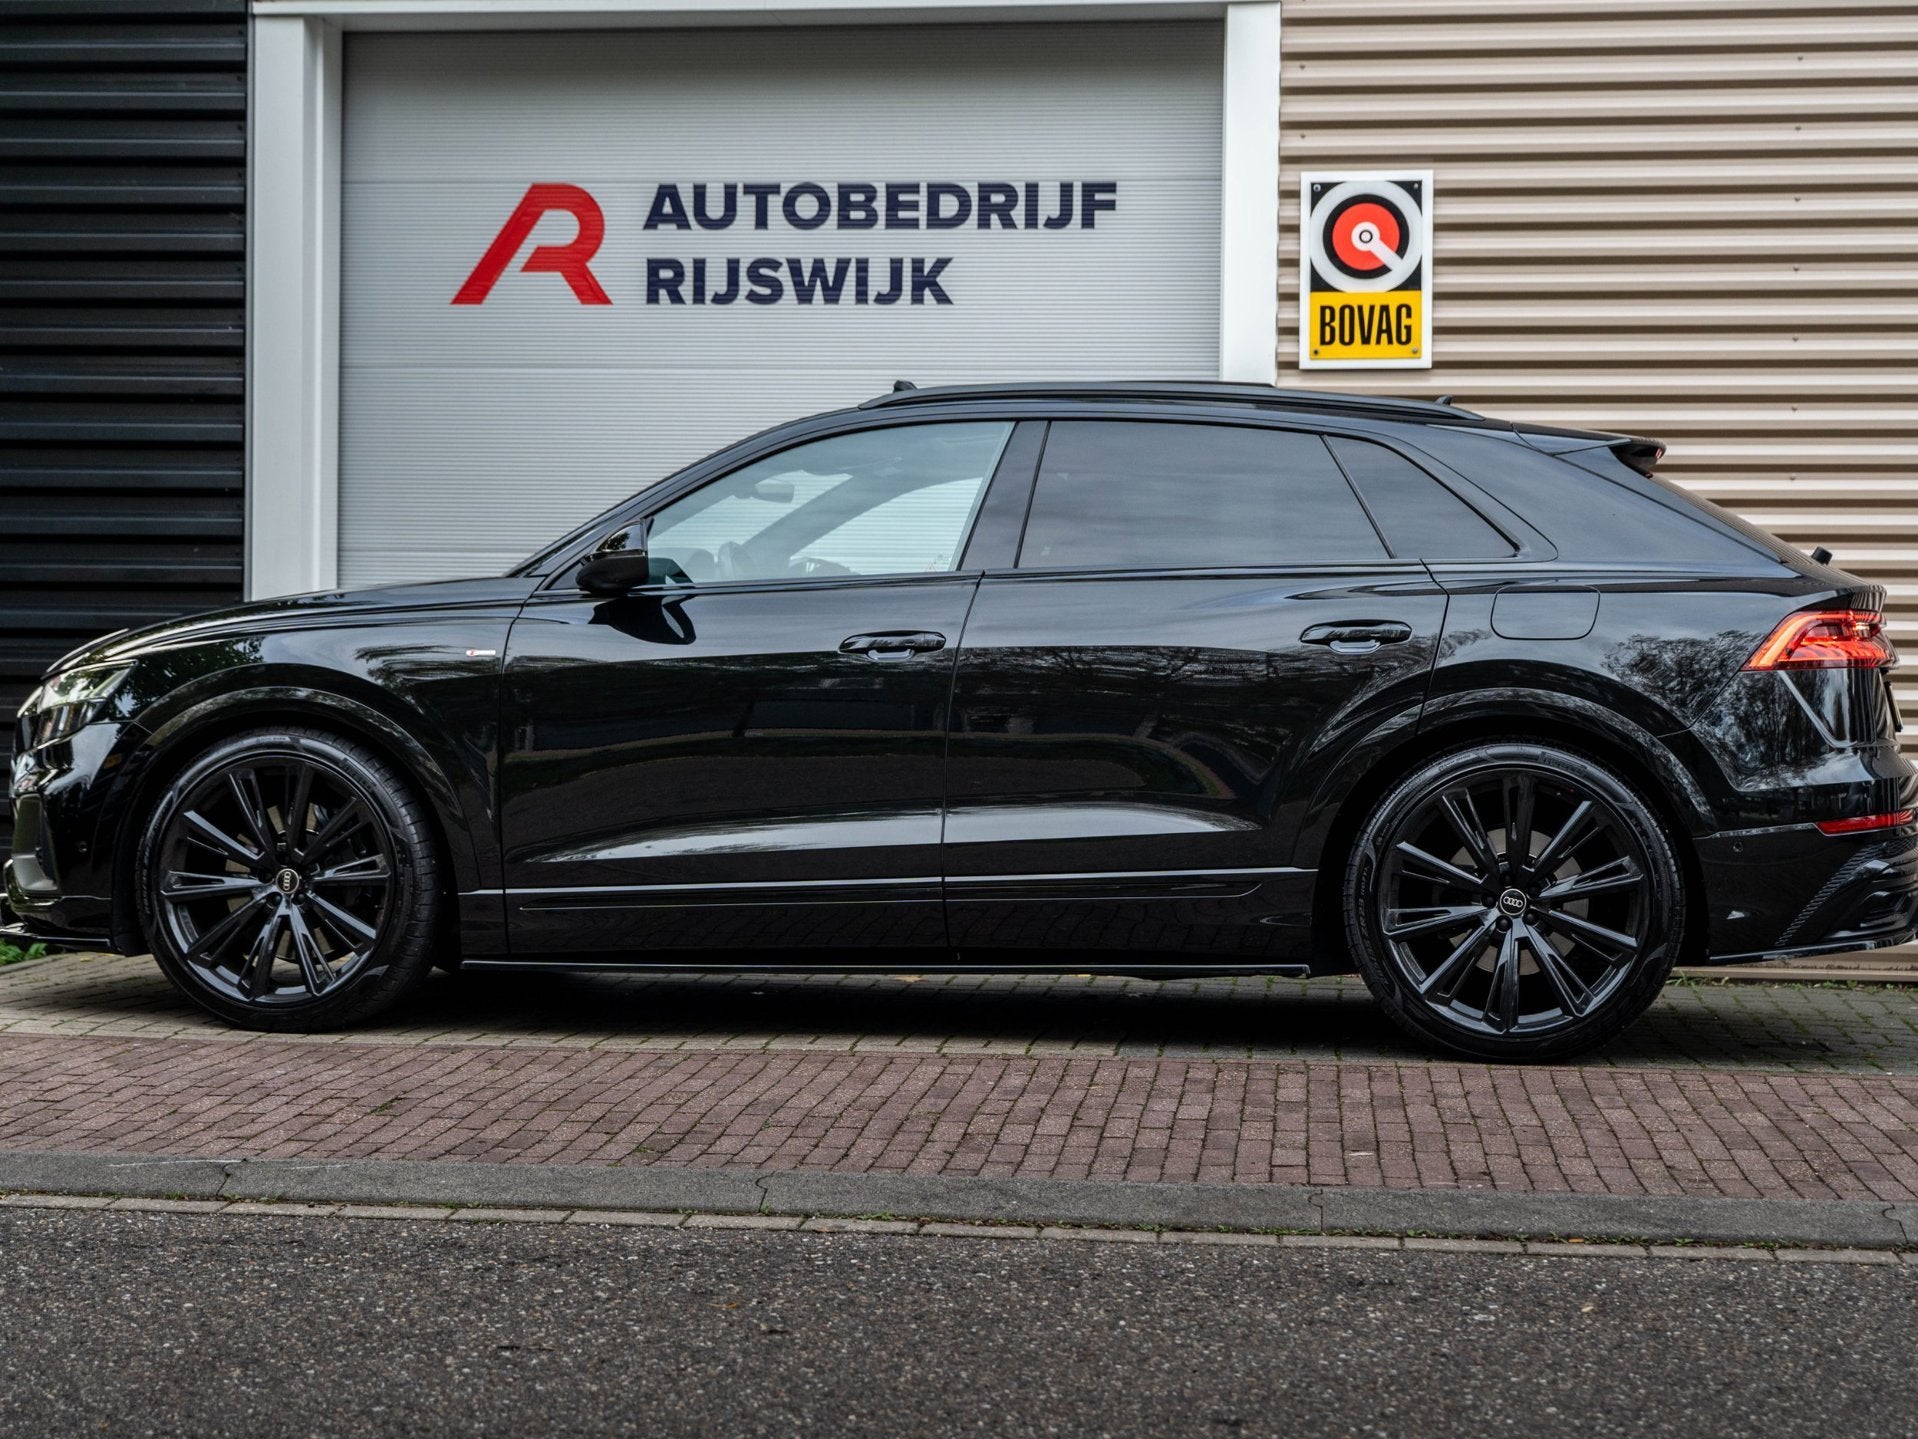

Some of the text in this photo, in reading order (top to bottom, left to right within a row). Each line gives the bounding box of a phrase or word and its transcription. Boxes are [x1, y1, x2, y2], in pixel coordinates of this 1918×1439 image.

[644, 181, 1117, 231] AUTOBEDRIJF
[647, 257, 953, 306] RIJSWIJK
[1319, 303, 1412, 346] BOVAG
